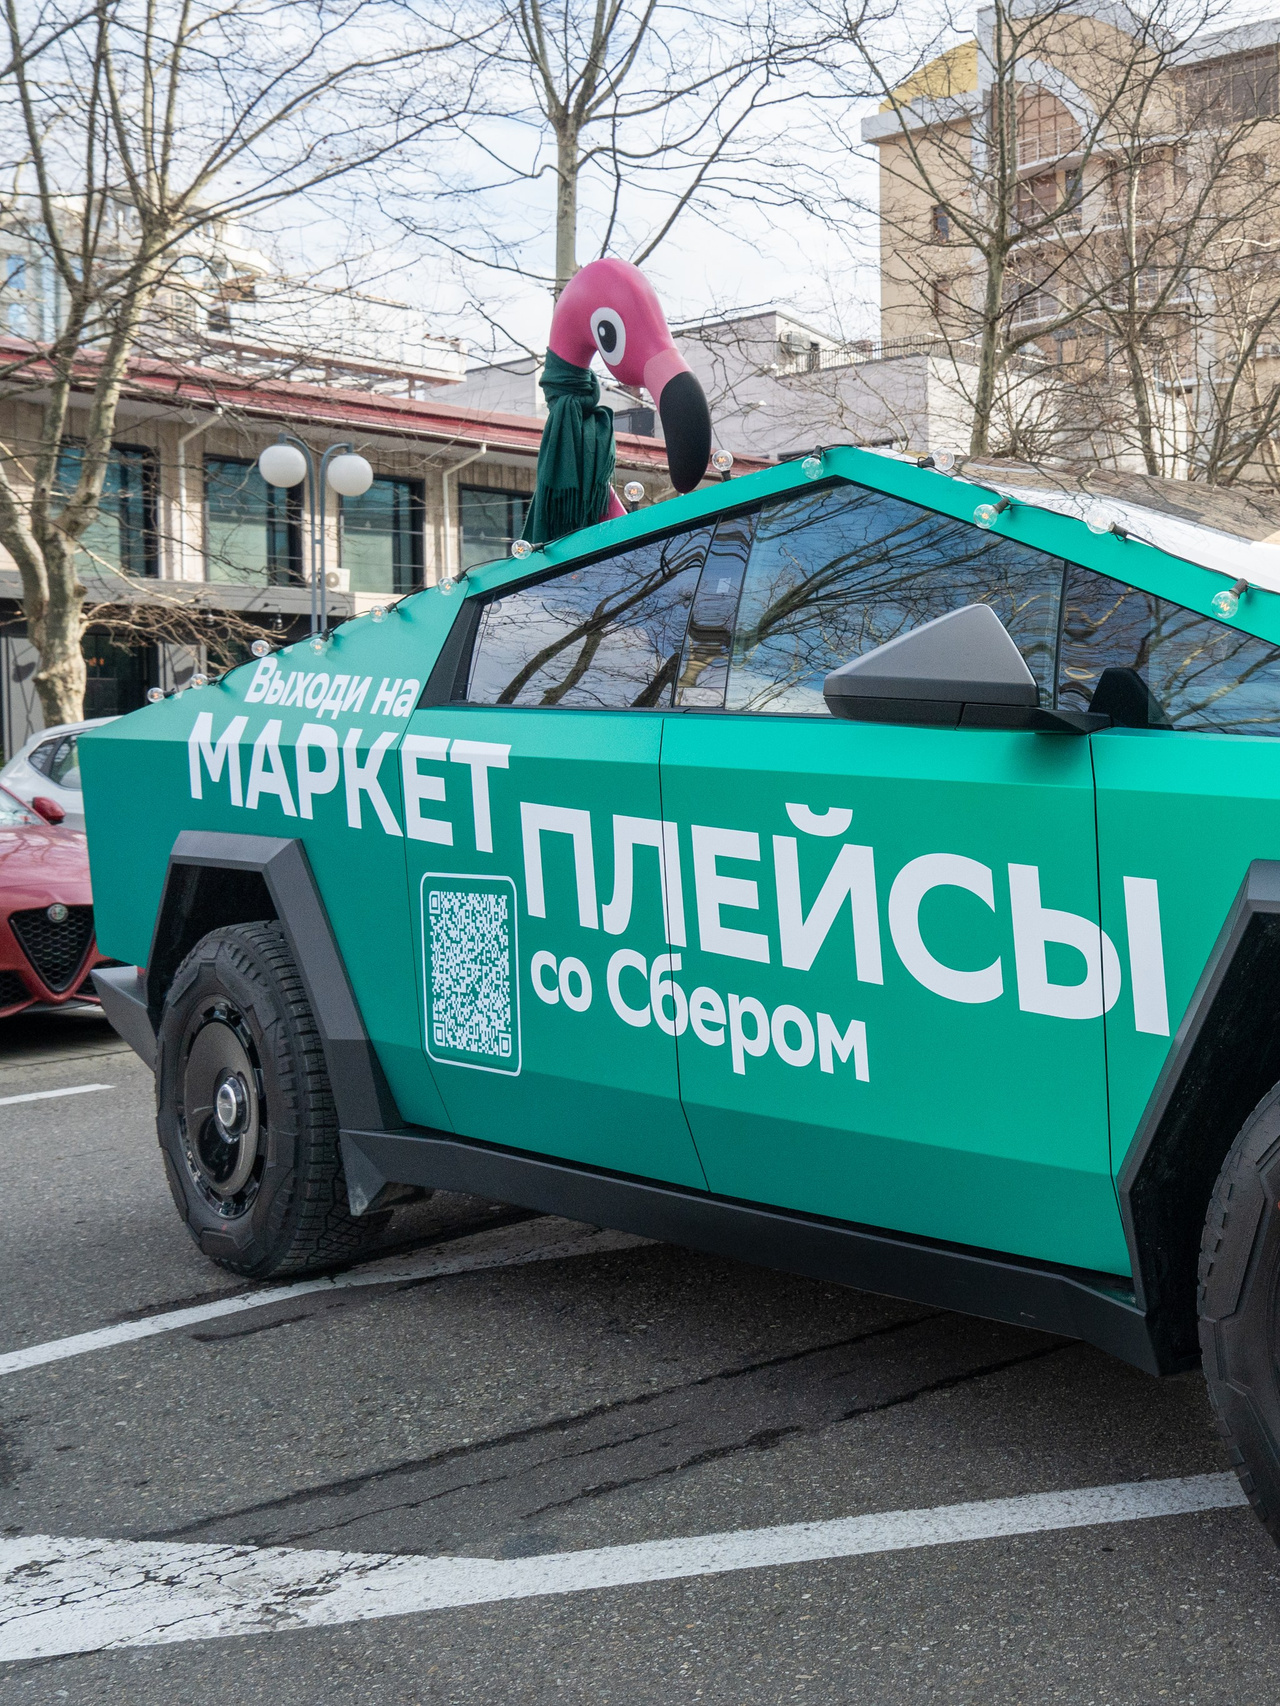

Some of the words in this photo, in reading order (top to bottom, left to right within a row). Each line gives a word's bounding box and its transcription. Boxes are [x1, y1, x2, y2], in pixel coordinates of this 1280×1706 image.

[244, 657, 371, 719] Выходи
[373, 677, 421, 718] на
[187, 711, 512, 853] МАРКЕТ
[520, 802, 1170, 1037] ПЛЕЙСЫ
[530, 950, 593, 1012] со
[606, 948, 870, 1082] Сбером
